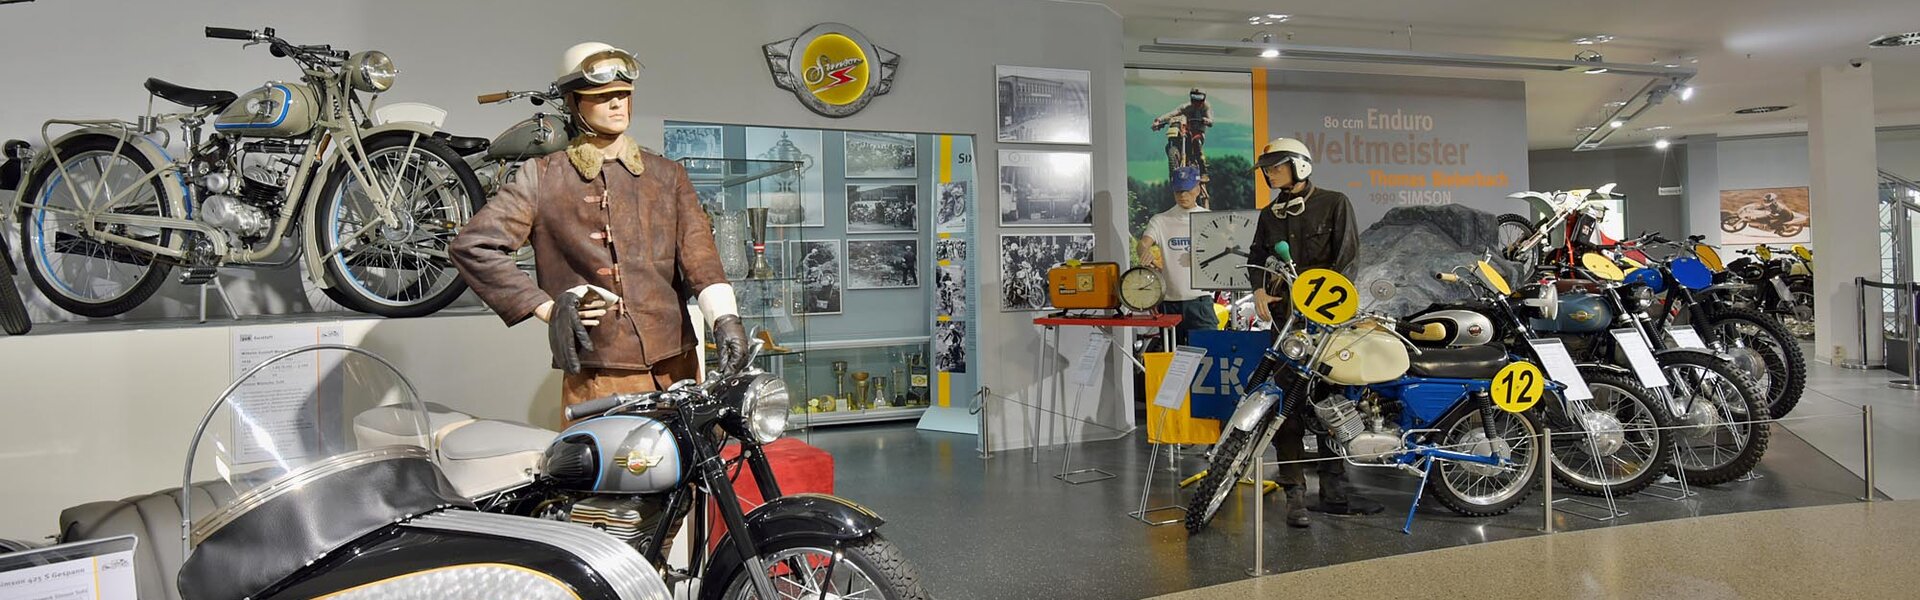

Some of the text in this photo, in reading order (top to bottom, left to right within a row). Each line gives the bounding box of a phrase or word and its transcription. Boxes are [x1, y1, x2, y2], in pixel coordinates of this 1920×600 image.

[1342, 118, 1364, 129] ccm
[1367, 108, 1433, 131] Enduro
[1295, 131, 1469, 166] Weltmeister
[1398, 190, 1452, 205] SIMSON
[1304, 276, 1348, 321] 12
[1502, 370, 1534, 404] 12
